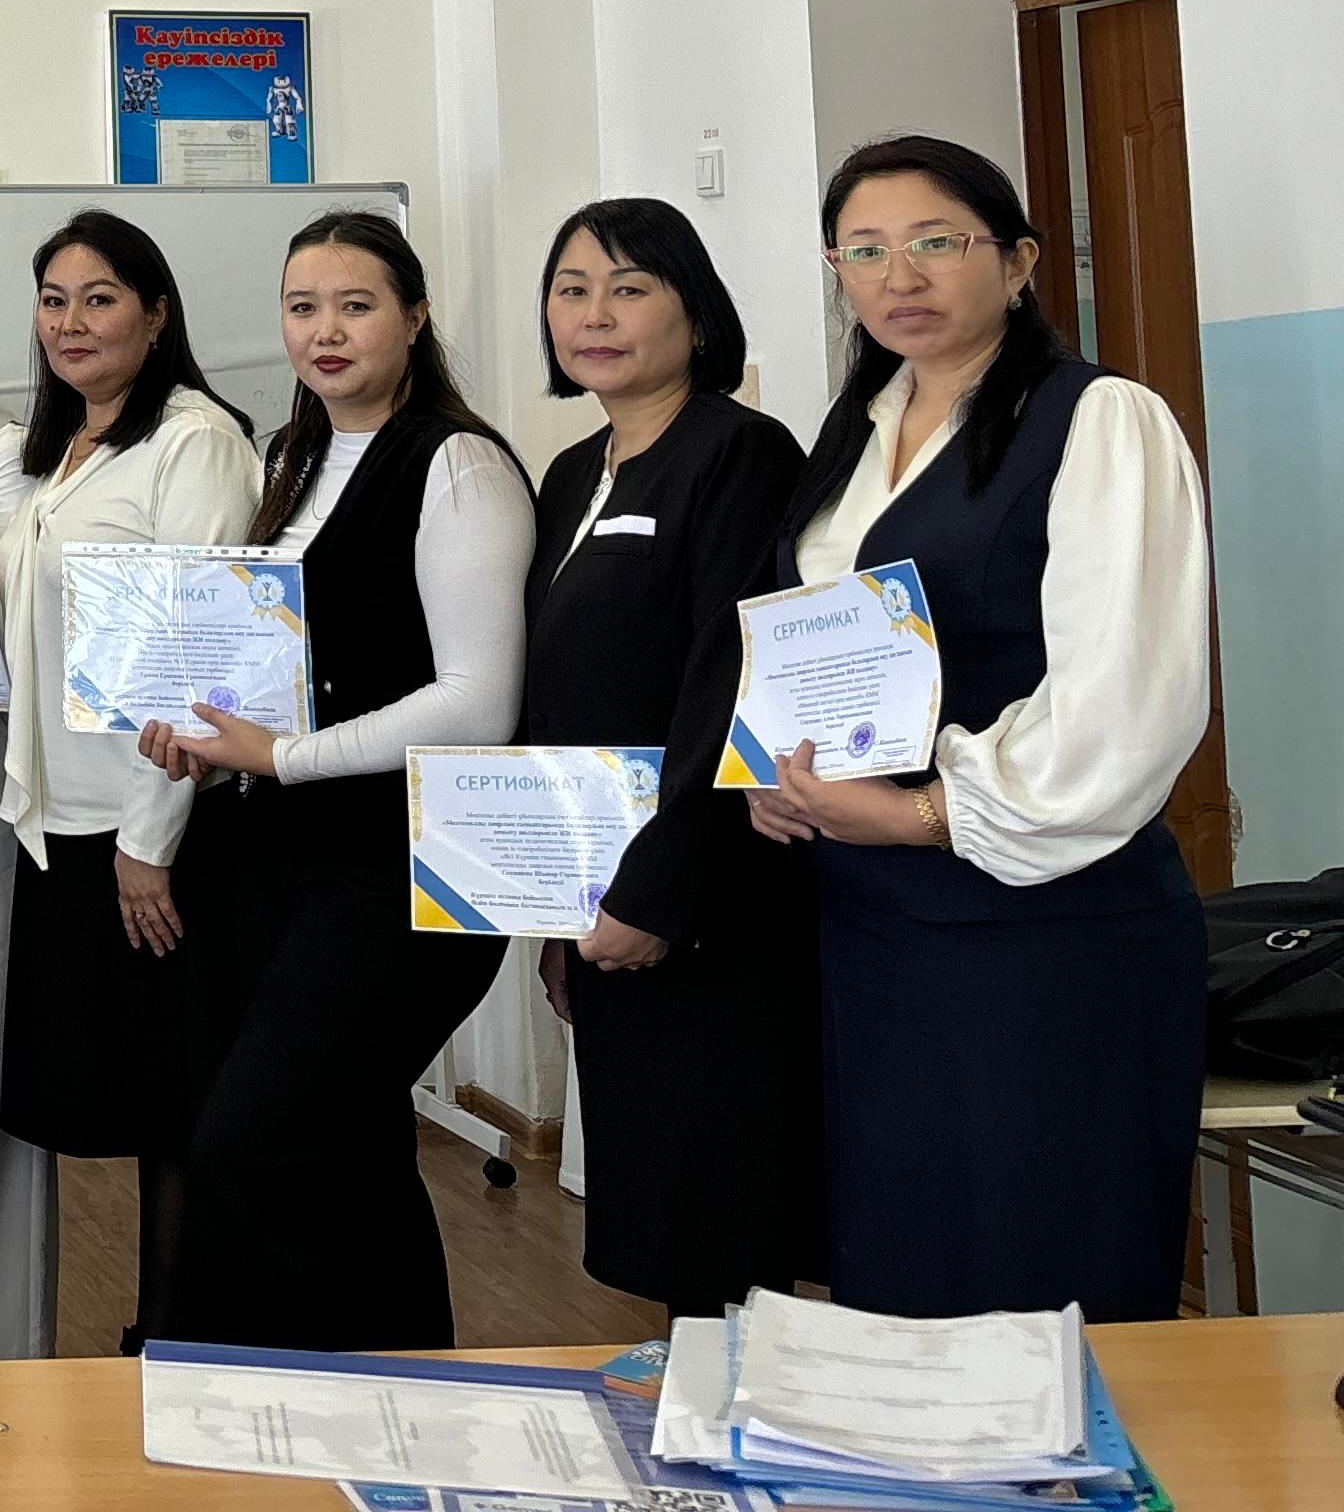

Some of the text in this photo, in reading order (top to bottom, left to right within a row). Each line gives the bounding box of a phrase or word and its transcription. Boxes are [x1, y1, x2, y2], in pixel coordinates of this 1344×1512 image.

[135, 25, 285, 48] Қауіпсіздік
[144, 50, 277, 72] ережелері
[773, 606, 860, 641] СЕРТИФИКАТ
[455, 774, 585, 792] СЕРТИФИКАТ
